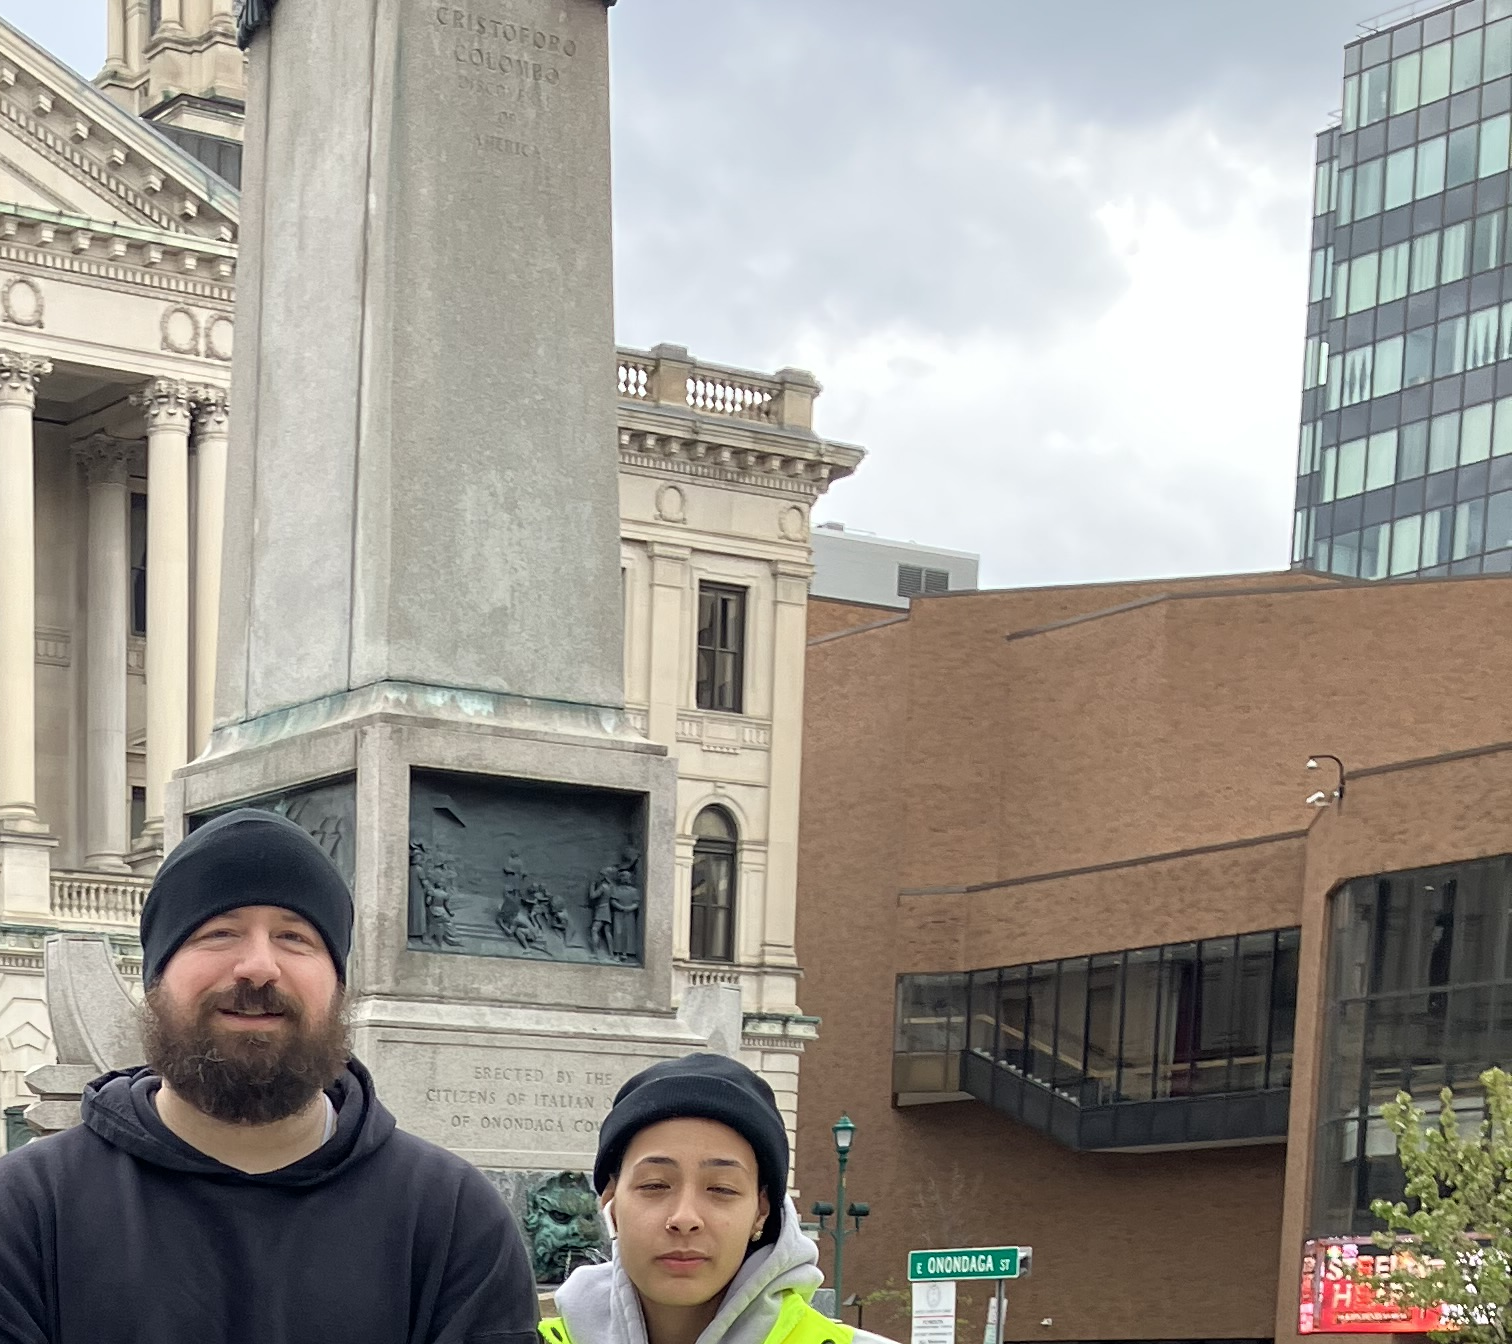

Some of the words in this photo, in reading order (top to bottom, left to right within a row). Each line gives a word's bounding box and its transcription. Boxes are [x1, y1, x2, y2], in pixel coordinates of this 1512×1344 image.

[436, 6, 577, 57] CRISTOFORO
[454, 44, 560, 85] COLOMBO
[474, 1066, 544, 1082] ERECTED
[557, 1070, 573, 1084] BY
[585, 1072, 613, 1086] THE
[426, 1089, 496, 1104] CITIZENS
[506, 1092, 526, 1106] OF
[534, 1093, 595, 1109] ITALIAN
[451, 1115, 470, 1128] OF
[481, 1116, 565, 1132] ONONDAGA
[916, 1262, 923, 1275] E
[928, 1254, 994, 1274] ONONDAGA
[999, 1258, 1011, 1272] ST
